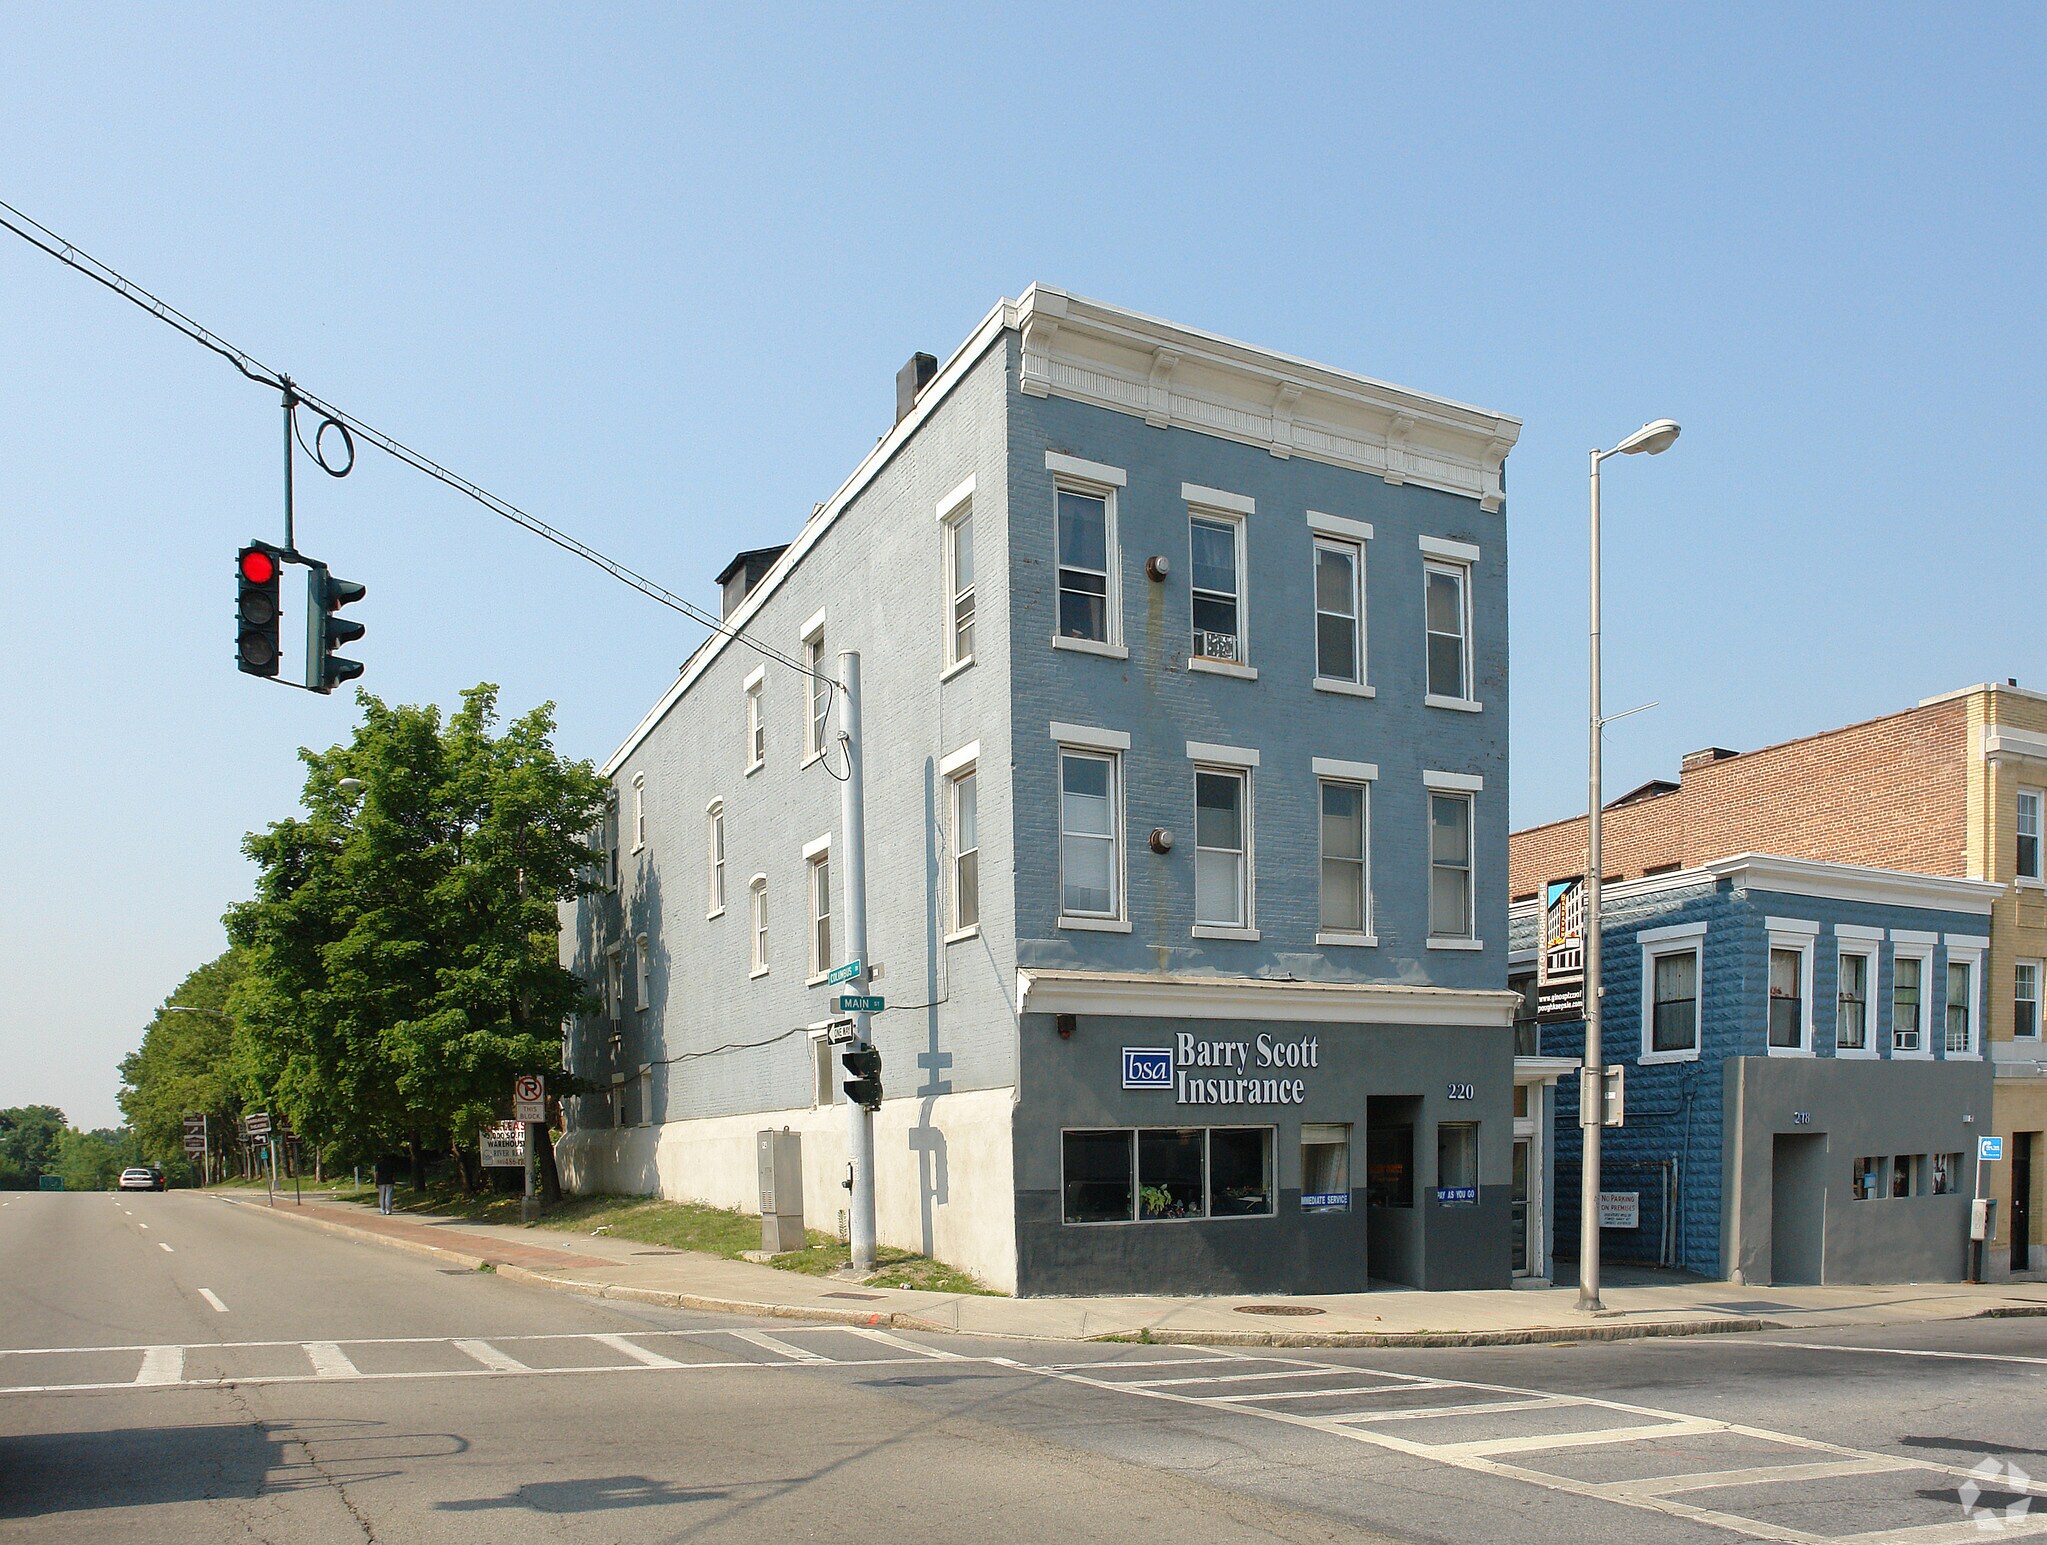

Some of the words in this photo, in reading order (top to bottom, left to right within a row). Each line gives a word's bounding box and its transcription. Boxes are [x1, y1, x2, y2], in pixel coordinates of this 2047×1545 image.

[1538, 881, 1546, 949] POUGHKEEPSIE
[1538, 951, 1546, 962] OF
[830, 966, 853, 983] COLUMBUS
[1538, 964, 1546, 985] CITY
[844, 998, 869, 1008] MAIN
[834, 1026, 843, 1038] ONE
[843, 1025, 851, 1036] WAY
[1175, 1032, 1250, 1076] Barry
[1256, 1033, 1319, 1068] Scott
[1129, 1054, 1168, 1080] bsa
[1176, 1070, 1305, 1104] Insurance
[1448, 1083, 1474, 1100] 220
[1794, 1111, 1811, 1124] 218
[1327, 1195, 1347, 1204] SERVICE
[1447, 1190, 1454, 1199] AS
[1456, 1190, 1466, 1199] YOU
[1467, 1189, 1475, 1198] GO
[1610, 1194, 1635, 1202] PARKING
